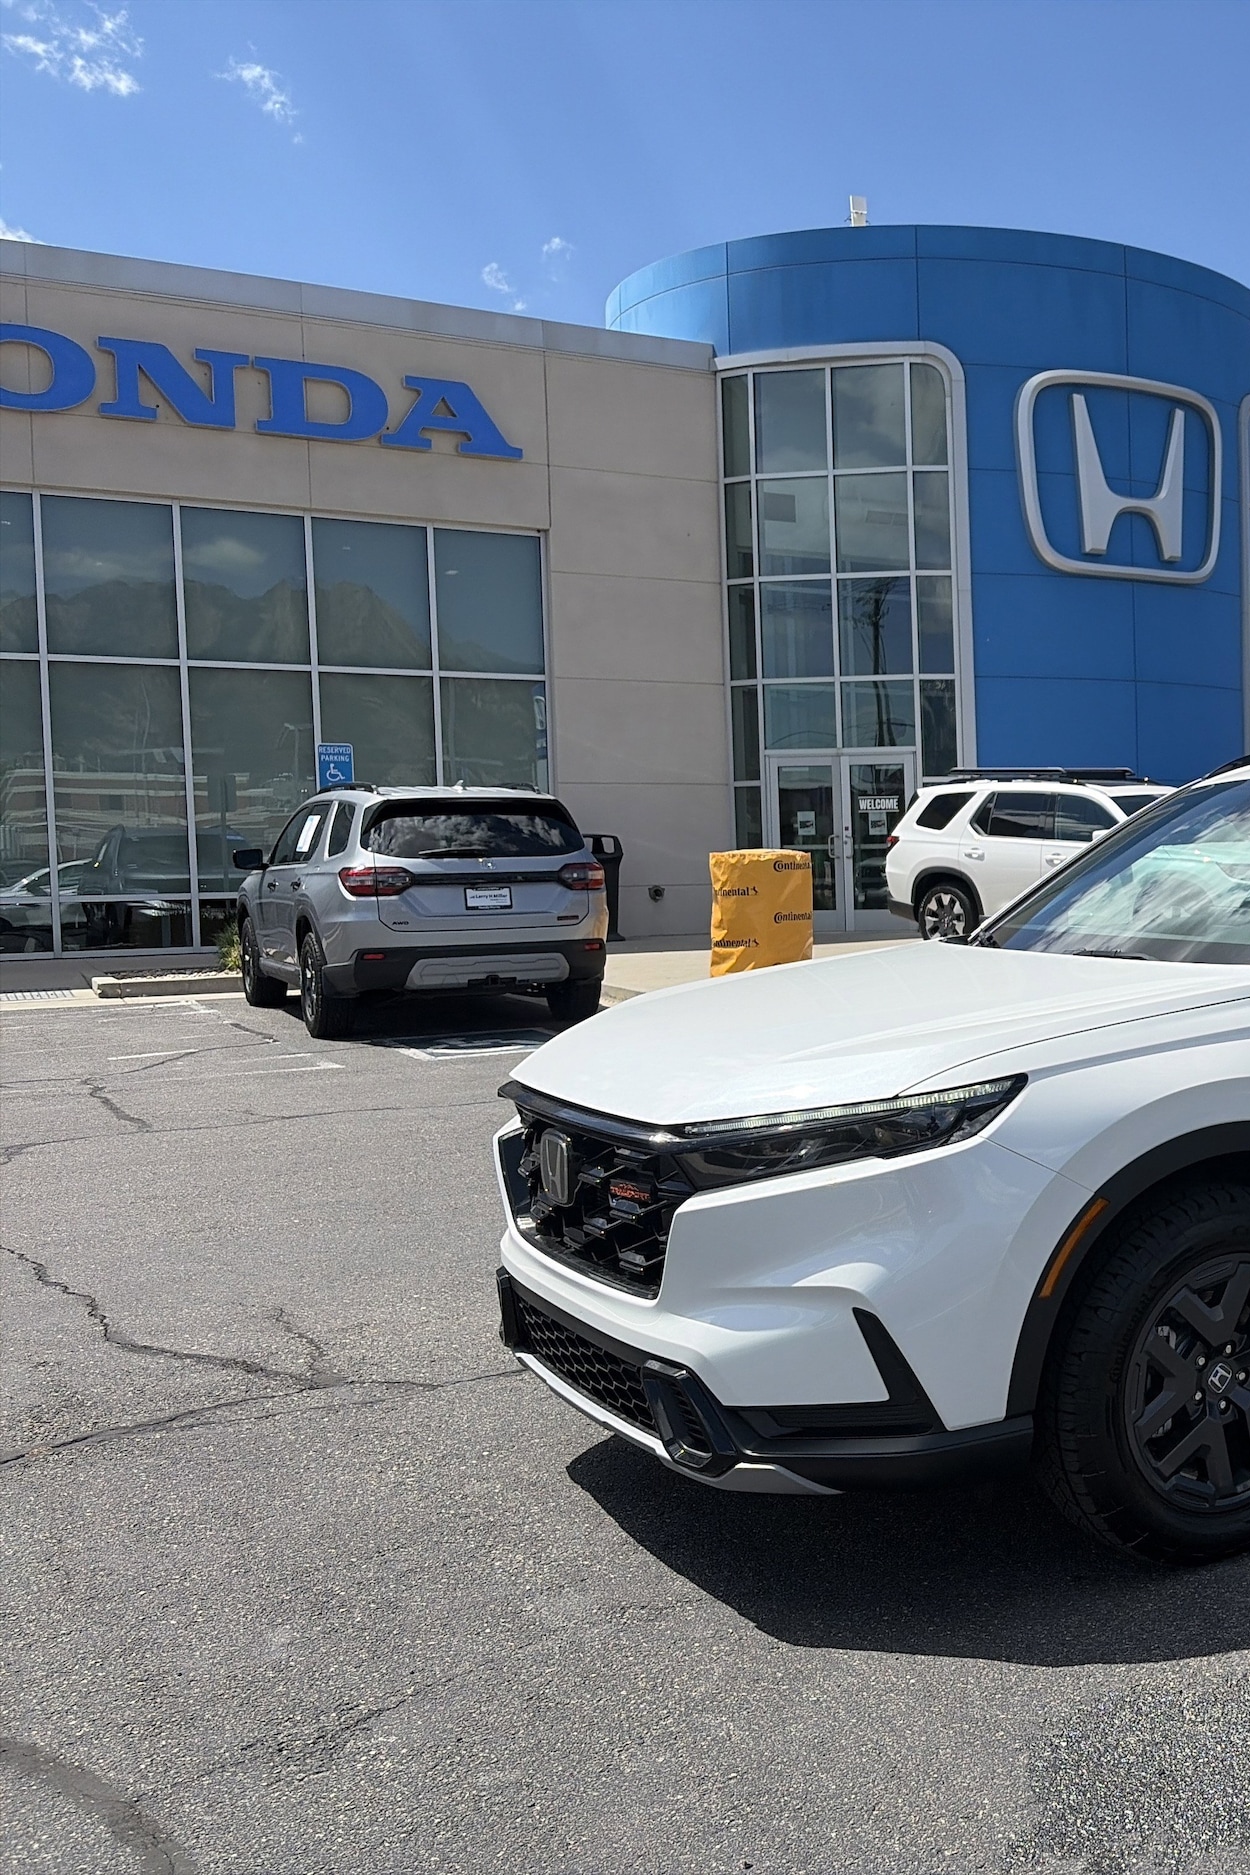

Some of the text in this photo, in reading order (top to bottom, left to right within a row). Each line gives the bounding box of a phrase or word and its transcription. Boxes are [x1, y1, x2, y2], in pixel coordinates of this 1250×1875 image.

[318, 746, 351, 754] RESERVED
[320, 754, 350, 762] PARKING
[858, 798, 899, 810] WELCOME
[773, 860, 811, 873] Continenta
[773, 911, 812, 924] Continenta
